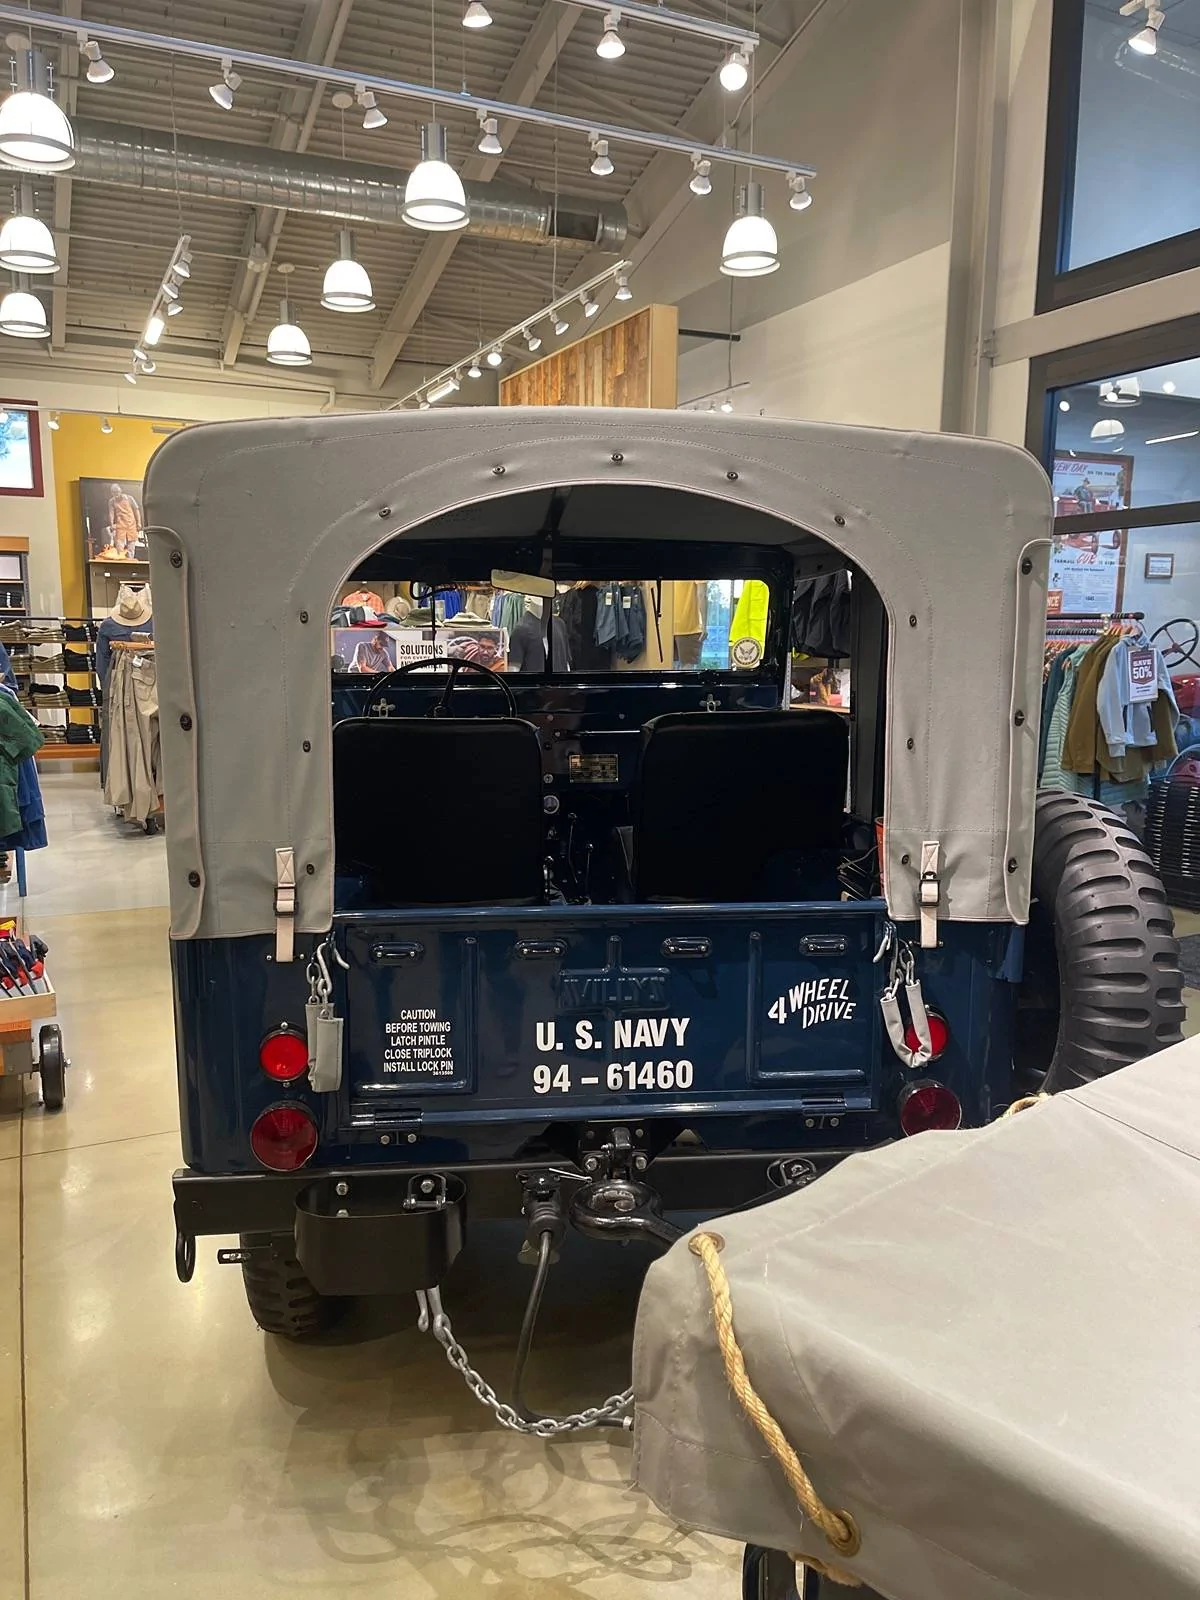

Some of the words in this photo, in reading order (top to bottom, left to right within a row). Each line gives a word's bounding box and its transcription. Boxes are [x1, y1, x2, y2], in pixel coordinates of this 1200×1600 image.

[1070, 462, 1088, 473] DAY
[400, 644, 444, 655] SOLUTIONS
[1132, 659, 1153, 667] SAVE
[1132, 665, 1153, 680] 50%
[767, 996, 788, 1025] 4
[788, 978, 850, 1013] WHEEL
[400, 1009, 436, 1020] CAUTION
[802, 1001, 857, 1029] DRIVE
[385, 1023, 418, 1033] BEFORE
[419, 1021, 451, 1033] TOWING
[390, 1036, 417, 1046] LATCH
[418, 1035, 446, 1046] PINTLE
[536, 1021, 564, 1051] U.
[575, 1020, 602, 1050] S.
[614, 1018, 690, 1049] NAVY
[384, 1049, 412, 1059] CLOSE
[413, 1048, 452, 1059] TRIPLOCK
[383, 1062, 416, 1072] INSTALL
[417, 1061, 439, 1072] LOCK
[440, 1060, 454, 1071] PIN
[533, 1064, 571, 1094] 94
[607, 1060, 694, 1091] 61460
